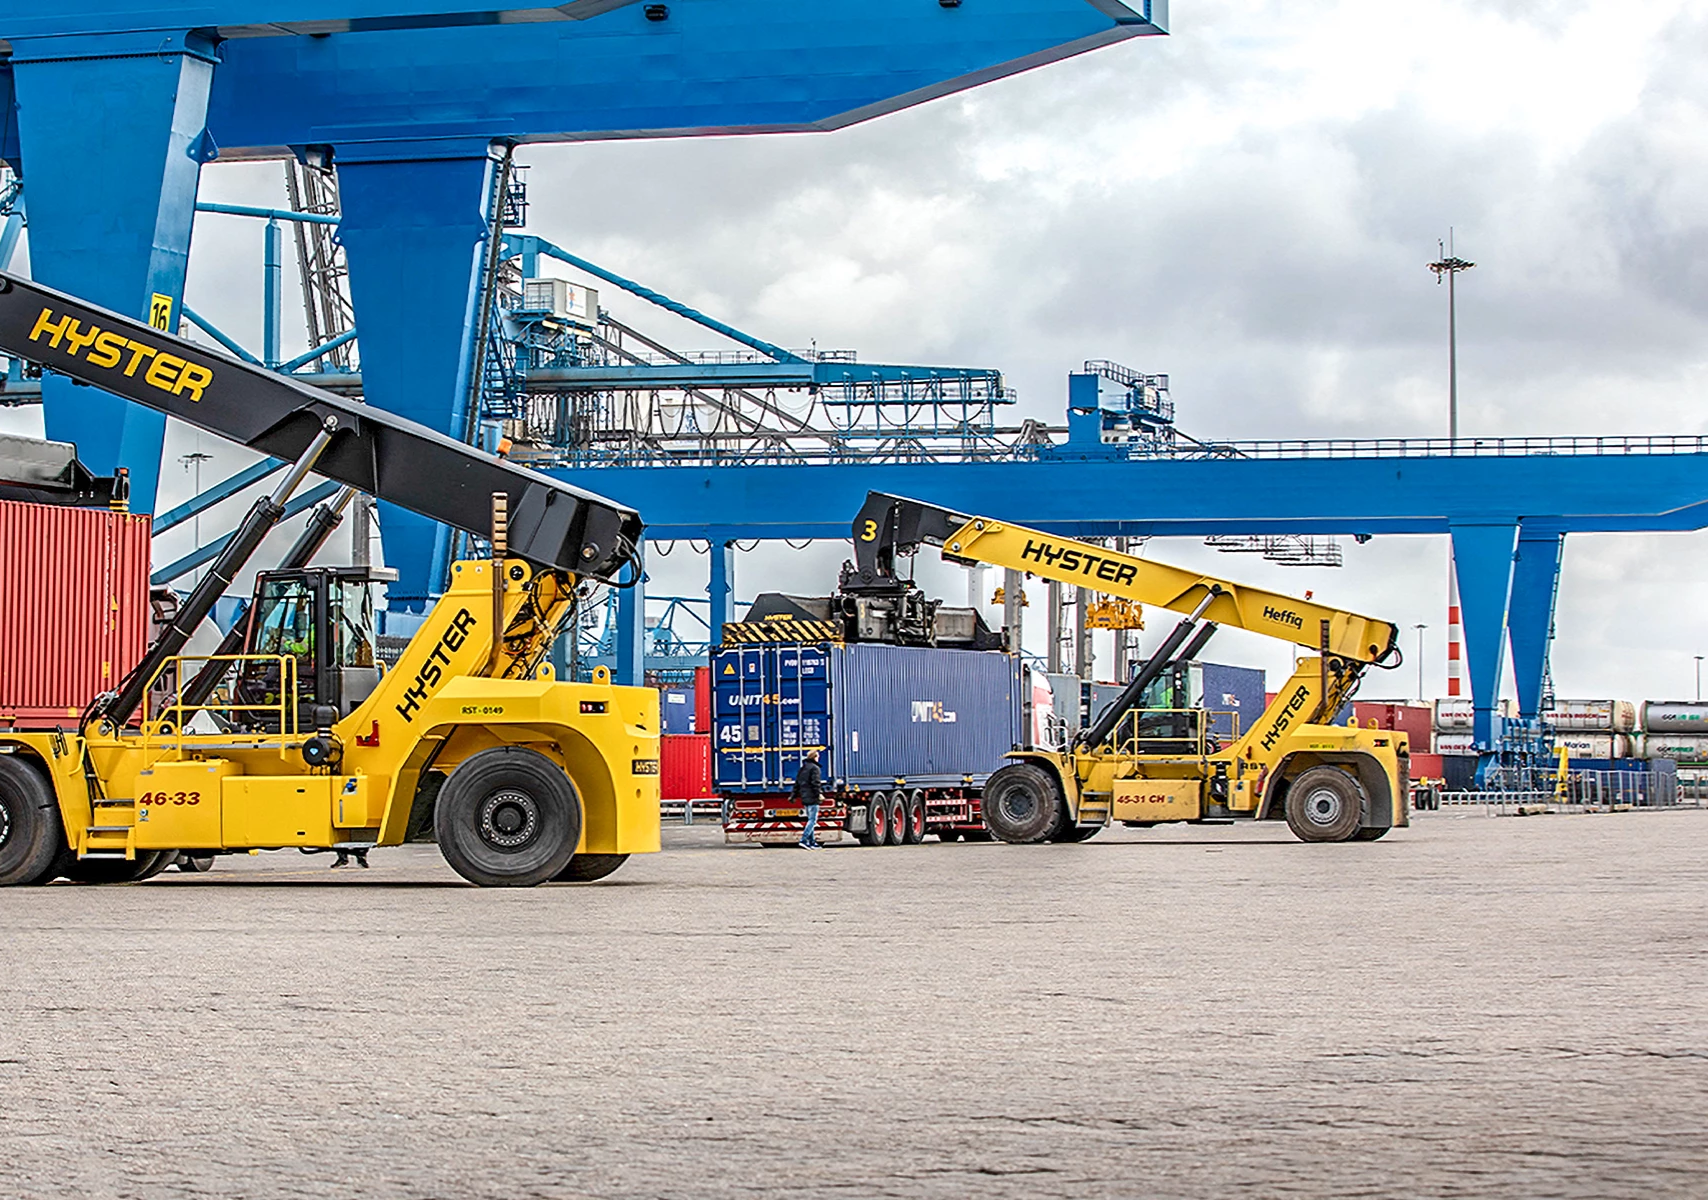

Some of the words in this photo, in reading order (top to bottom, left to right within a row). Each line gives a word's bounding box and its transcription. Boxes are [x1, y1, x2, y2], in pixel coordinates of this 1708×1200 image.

[153, 303, 167, 332] 16
[29, 308, 213, 402] HYSTER
[861, 519, 878, 542] 3
[1021, 540, 1138, 586] HYSTER
[395, 608, 477, 723] HYSTER
[1260, 685, 1310, 751] HYSTER
[720, 725, 742, 743] 45
[139, 792, 201, 806] 46-33
[1117, 795, 1146, 804] 45-31
[1149, 795, 1165, 803] CH
